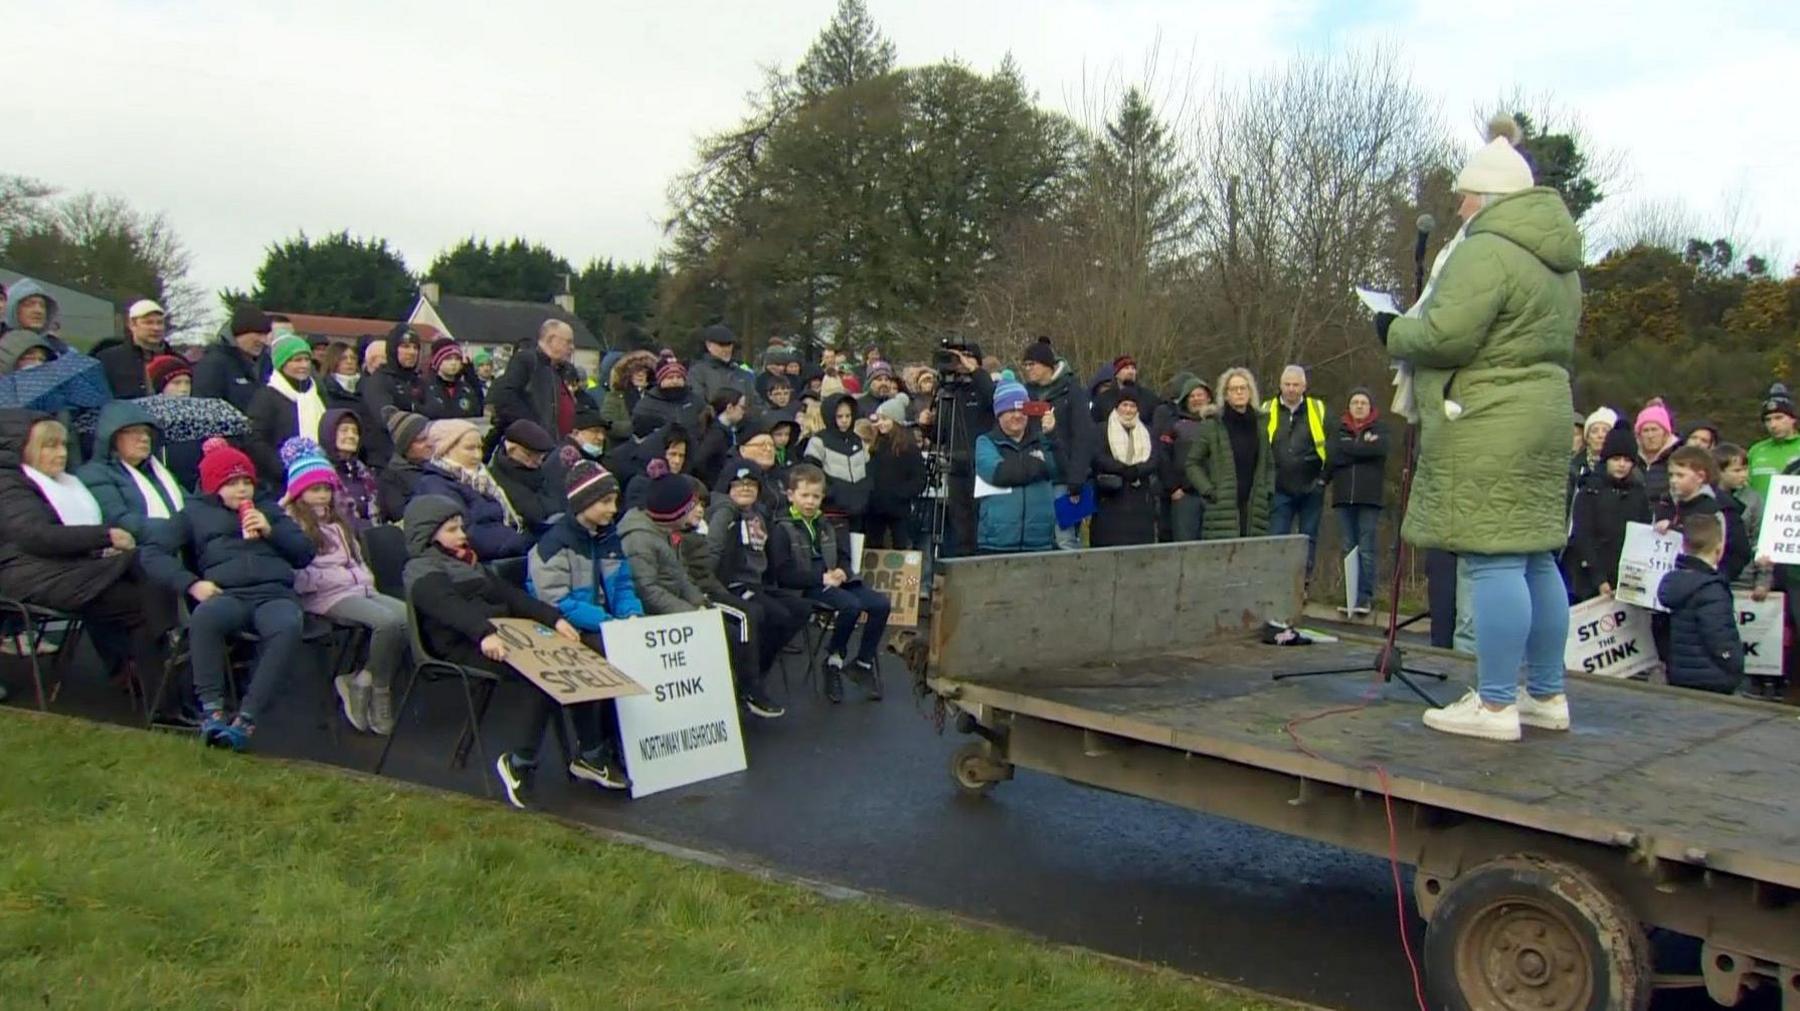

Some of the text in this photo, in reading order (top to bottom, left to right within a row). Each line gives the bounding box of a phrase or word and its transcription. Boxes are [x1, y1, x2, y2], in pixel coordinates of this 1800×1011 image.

[645, 626, 694, 649] STOP
[1577, 611, 1627, 642] STOP
[1598, 635, 1616, 649] THE
[660, 651, 687, 669] THE
[1583, 639, 1639, 674] STINK
[655, 677, 704, 702] STINK
[639, 720, 728, 761] NORTHWAY MUSHROOMS
